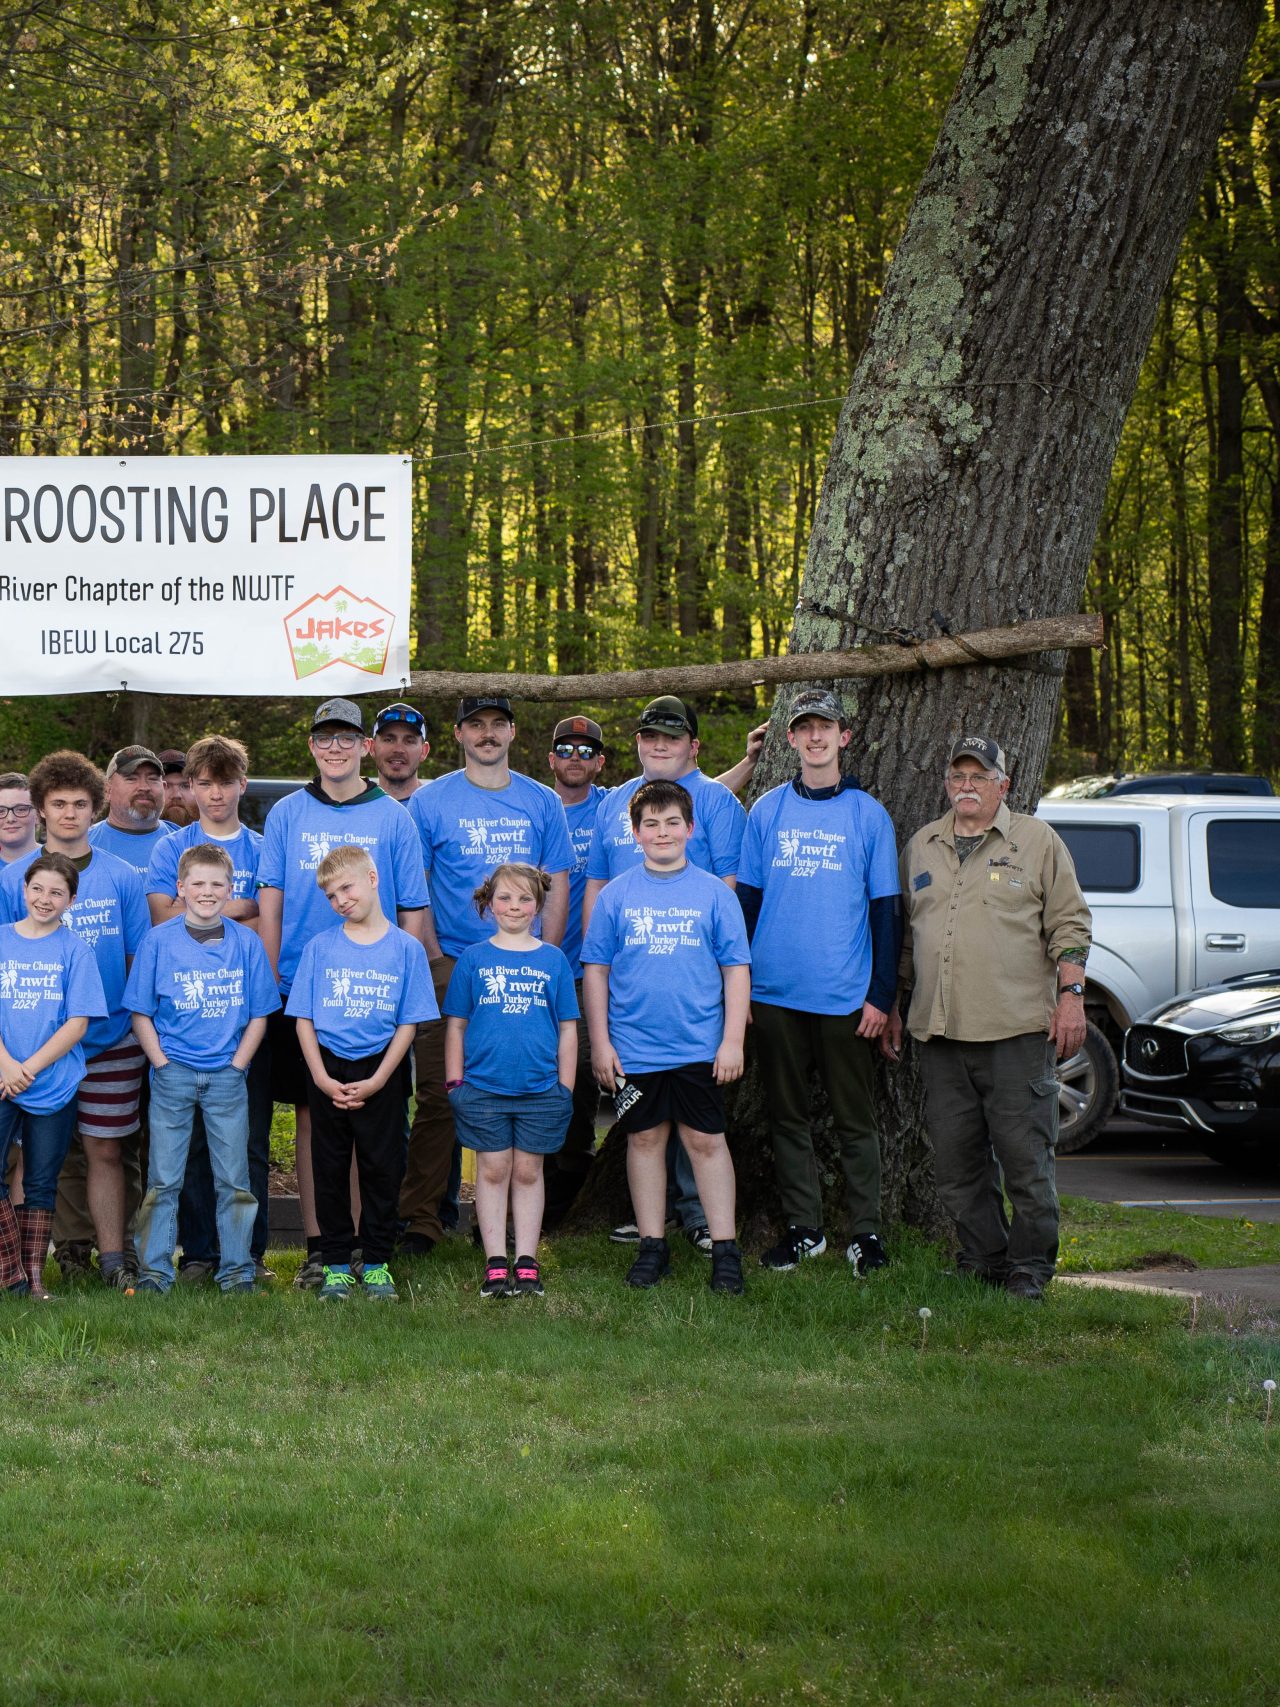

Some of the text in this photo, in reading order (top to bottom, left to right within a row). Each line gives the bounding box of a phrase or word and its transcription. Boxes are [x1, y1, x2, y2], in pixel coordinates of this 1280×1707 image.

[5, 484, 228, 545] ROOSTING
[249, 483, 385, 543] PLACE
[65, 575, 154, 606] Chapter
[161, 577, 182, 605] of
[188, 577, 224, 601] the
[233, 575, 295, 601] NWTF
[41, 630, 204, 656] IBEW Local 275
[459, 818, 531, 829] Flat River Chapter
[302, 832, 377, 845] Flat River Chapter
[790, 829, 812, 839] River
[813, 830, 846, 843] Chapter
[460, 845, 483, 856] Youth
[485, 845, 512, 856] Turkey
[299, 859, 319, 870] Yout
[485, 853, 510, 864] 2024
[794, 857, 820, 868] Turkey
[821, 858, 842, 870] Hunt
[791, 866, 816, 878] 2024
[85, 898, 116, 909] Chapter
[625, 907, 701, 918] Flat River Chapter
[101, 926, 119, 936] Hunt
[650, 935, 679, 945] Turkey
[681, 935, 700, 946] Hunt
[648, 944, 676, 955] 2024
[8, 960, 31, 970] River
[193, 970, 215, 980] River
[217, 968, 243, 979] Chapte
[325, 968, 398, 983] Flat River Chapter
[496, 965, 519, 975] River
[521, 966, 551, 981] Chapter
[13, 988, 42, 1000] Turkey
[503, 993, 532, 1004] Turkey
[12, 999, 39, 1010] 2024
[174, 999, 199, 1010] Youth
[202, 998, 229, 1008] Turkey
[322, 997, 395, 1012] Youth Turkey Hunt
[502, 1003, 529, 1015] 2024
[201, 1007, 227, 1018] 2024
[343, 1007, 370, 1019] 2024
